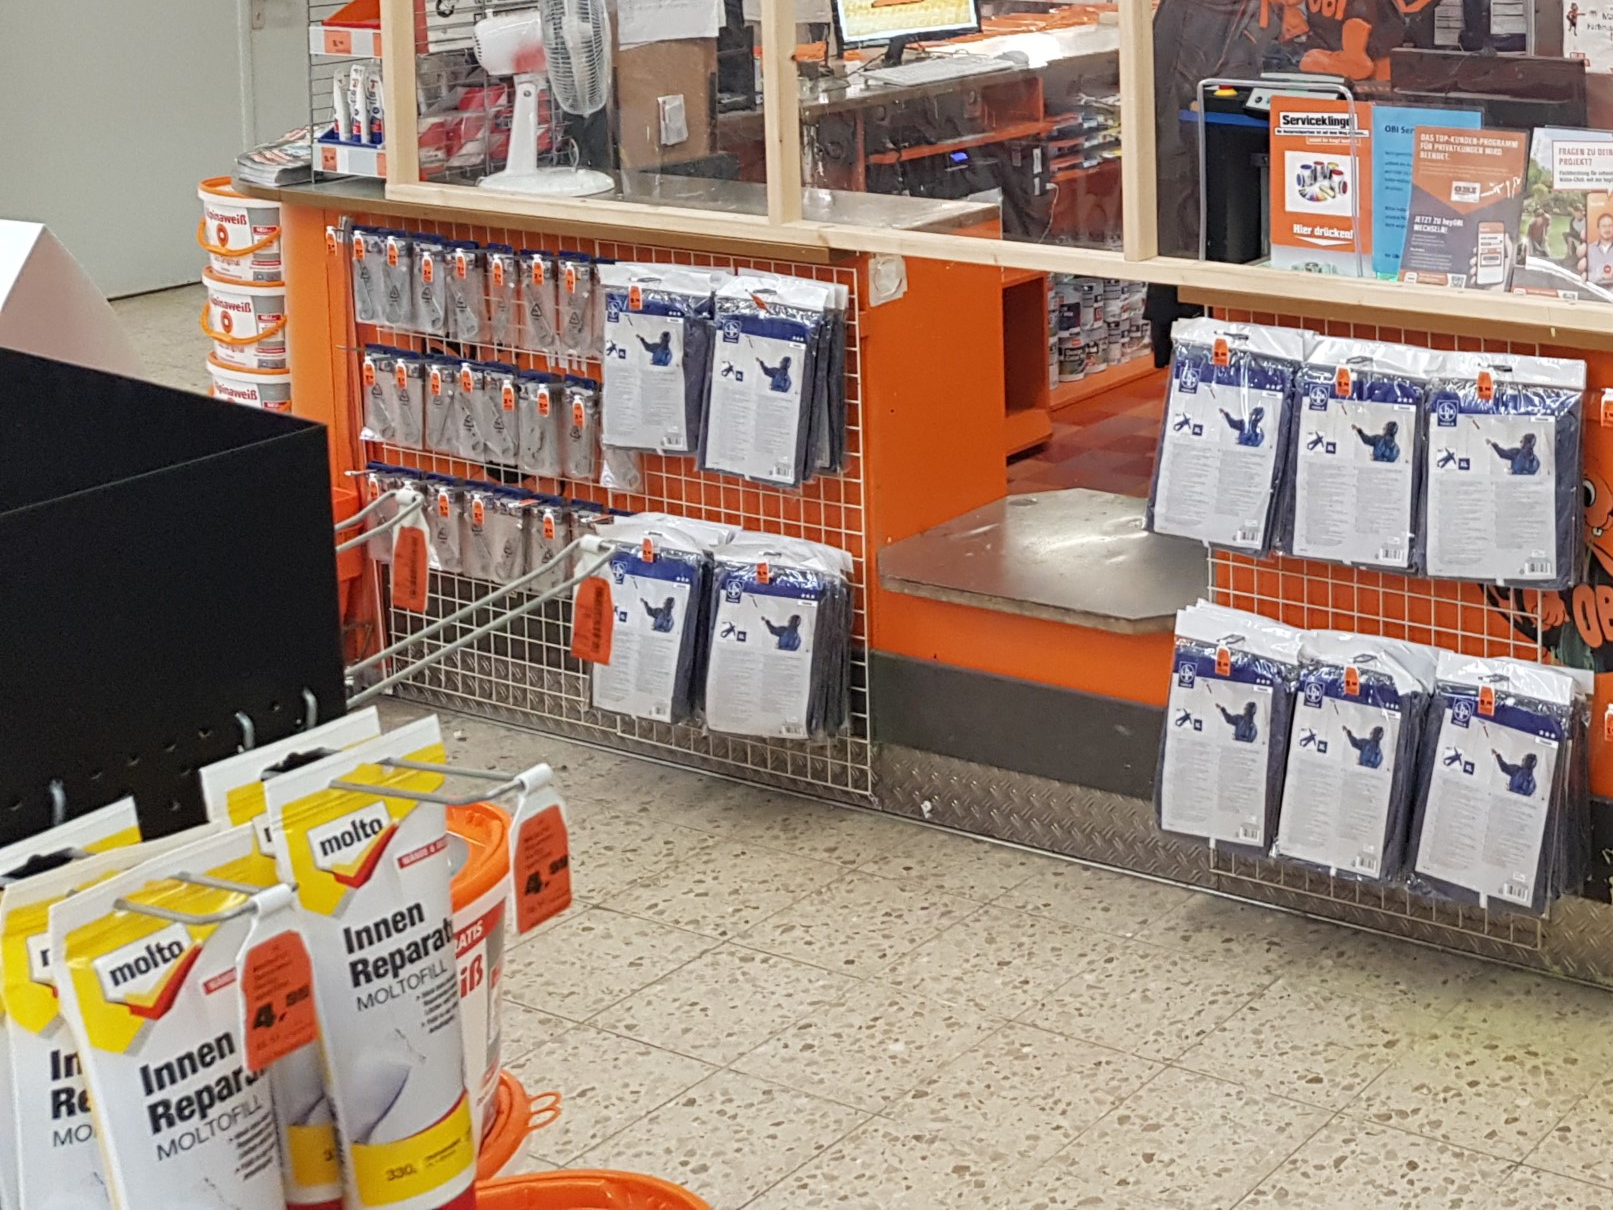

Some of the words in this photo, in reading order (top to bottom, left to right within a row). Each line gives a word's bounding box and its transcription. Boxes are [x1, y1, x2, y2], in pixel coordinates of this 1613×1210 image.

[1385, 125, 1399, 133] OBI
[1559, 148, 1585, 156] FRAGEN
[1293, 224, 1312, 235] Hier
[1314, 226, 1354, 239] drücken!
[319, 815, 384, 857] molto
[343, 902, 425, 955] Innen
[109, 940, 184, 987] molto
[356, 961, 447, 1013] MOLTOFILL
[139, 1031, 236, 1097] Innen
[147, 1064, 268, 1135] Repar
[157, 1094, 262, 1161] MOLTOFILL
